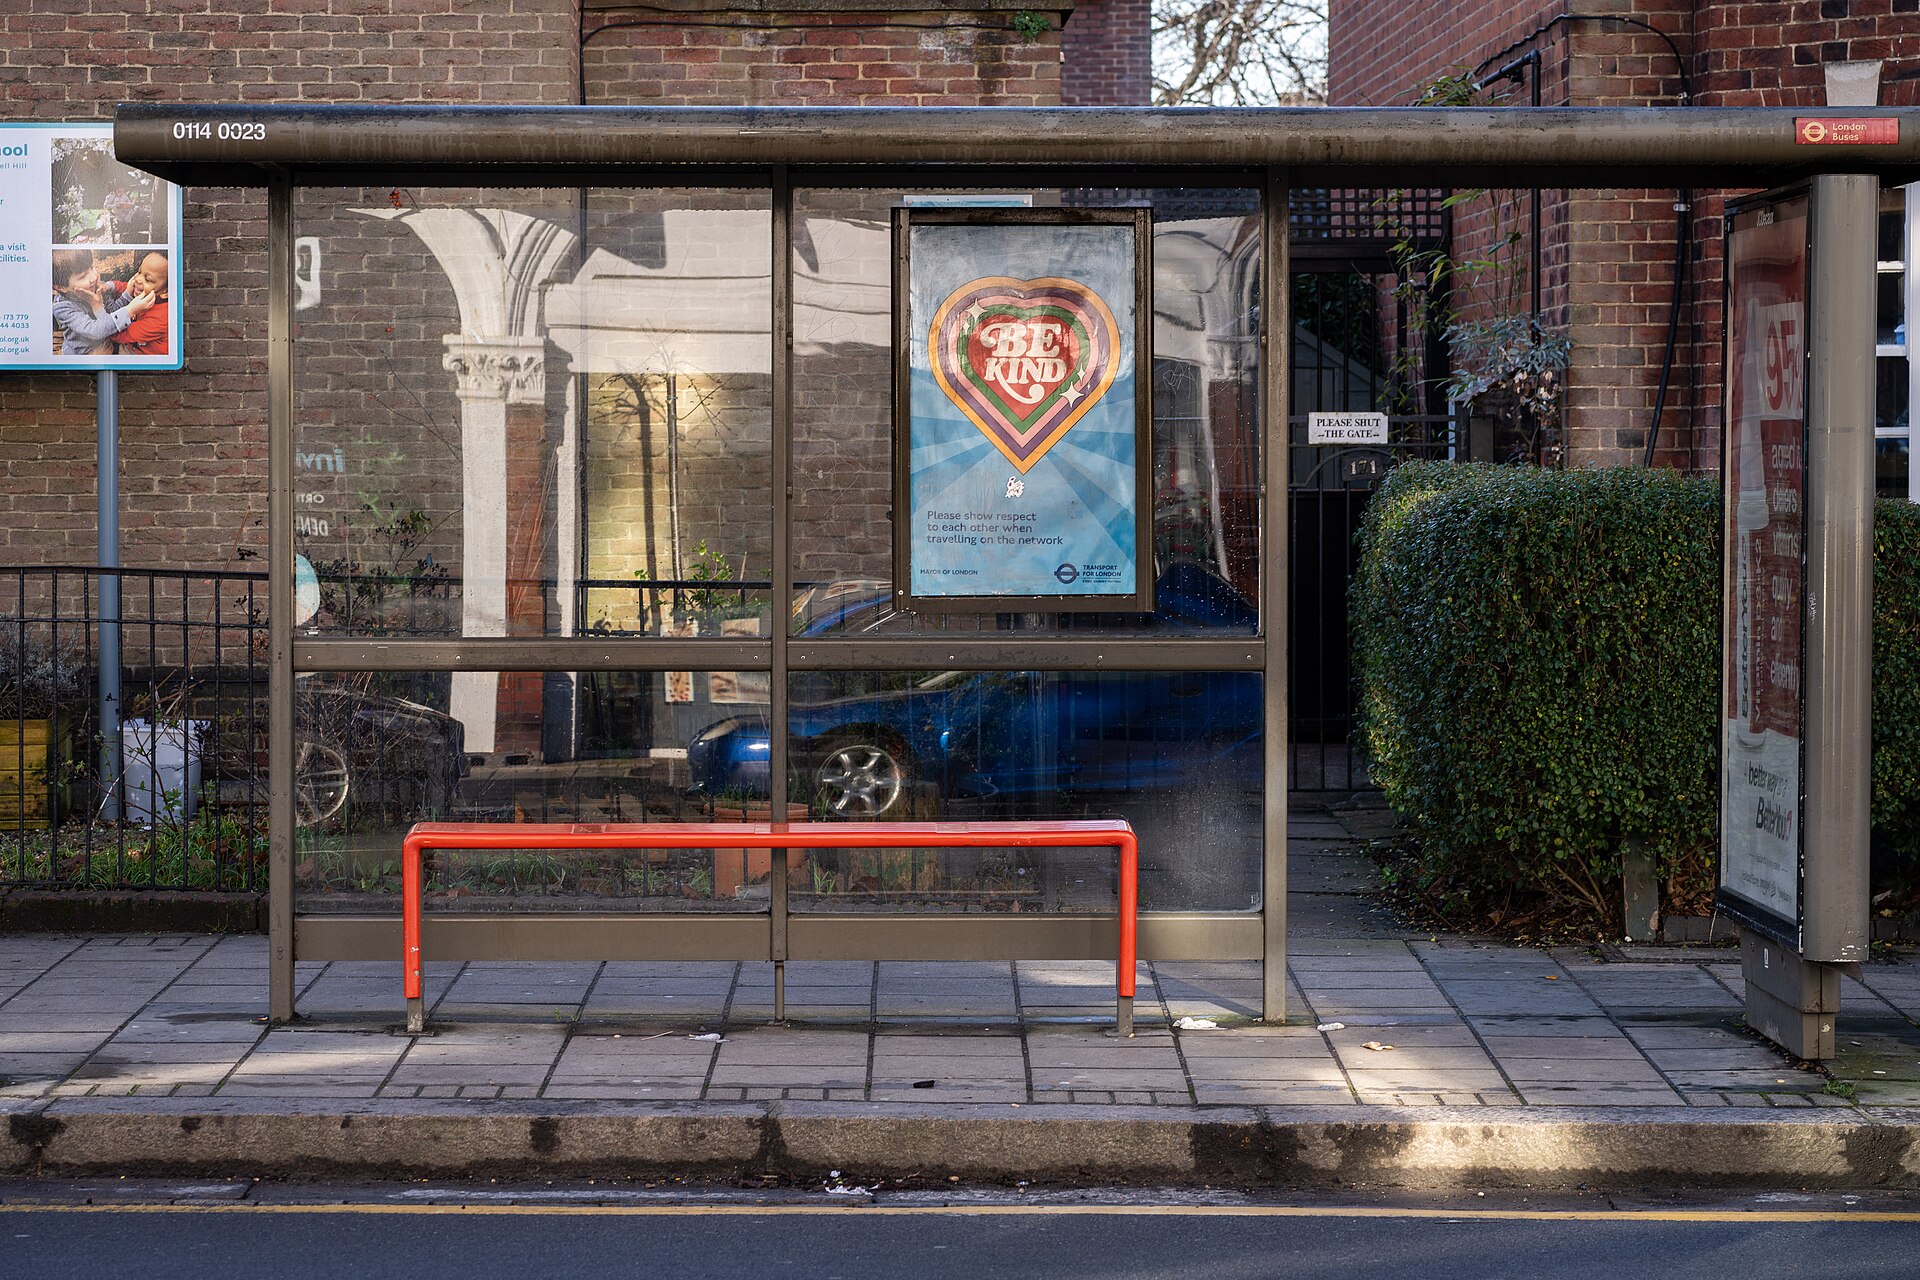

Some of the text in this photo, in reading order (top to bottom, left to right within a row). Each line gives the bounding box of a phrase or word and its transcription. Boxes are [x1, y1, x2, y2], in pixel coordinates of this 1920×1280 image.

[173, 122, 266, 140] 0114 0023
[1832, 122, 1867, 131] London
[1832, 133, 1859, 141] Buses
[0, 143, 28, 156] ool
[7, 242, 26, 251] visit
[979, 322, 1062, 358] BE
[984, 357, 1068, 405] KIND
[1316, 418, 1381, 427] PLEASE SHUT
[1324, 429, 1373, 438] THE GATE
[1350, 459, 1376, 475] 171
[927, 510, 1037, 523] Please show respect
[927, 523, 1033, 533] to each other when
[927, 535, 1063, 546] travelling on the network
